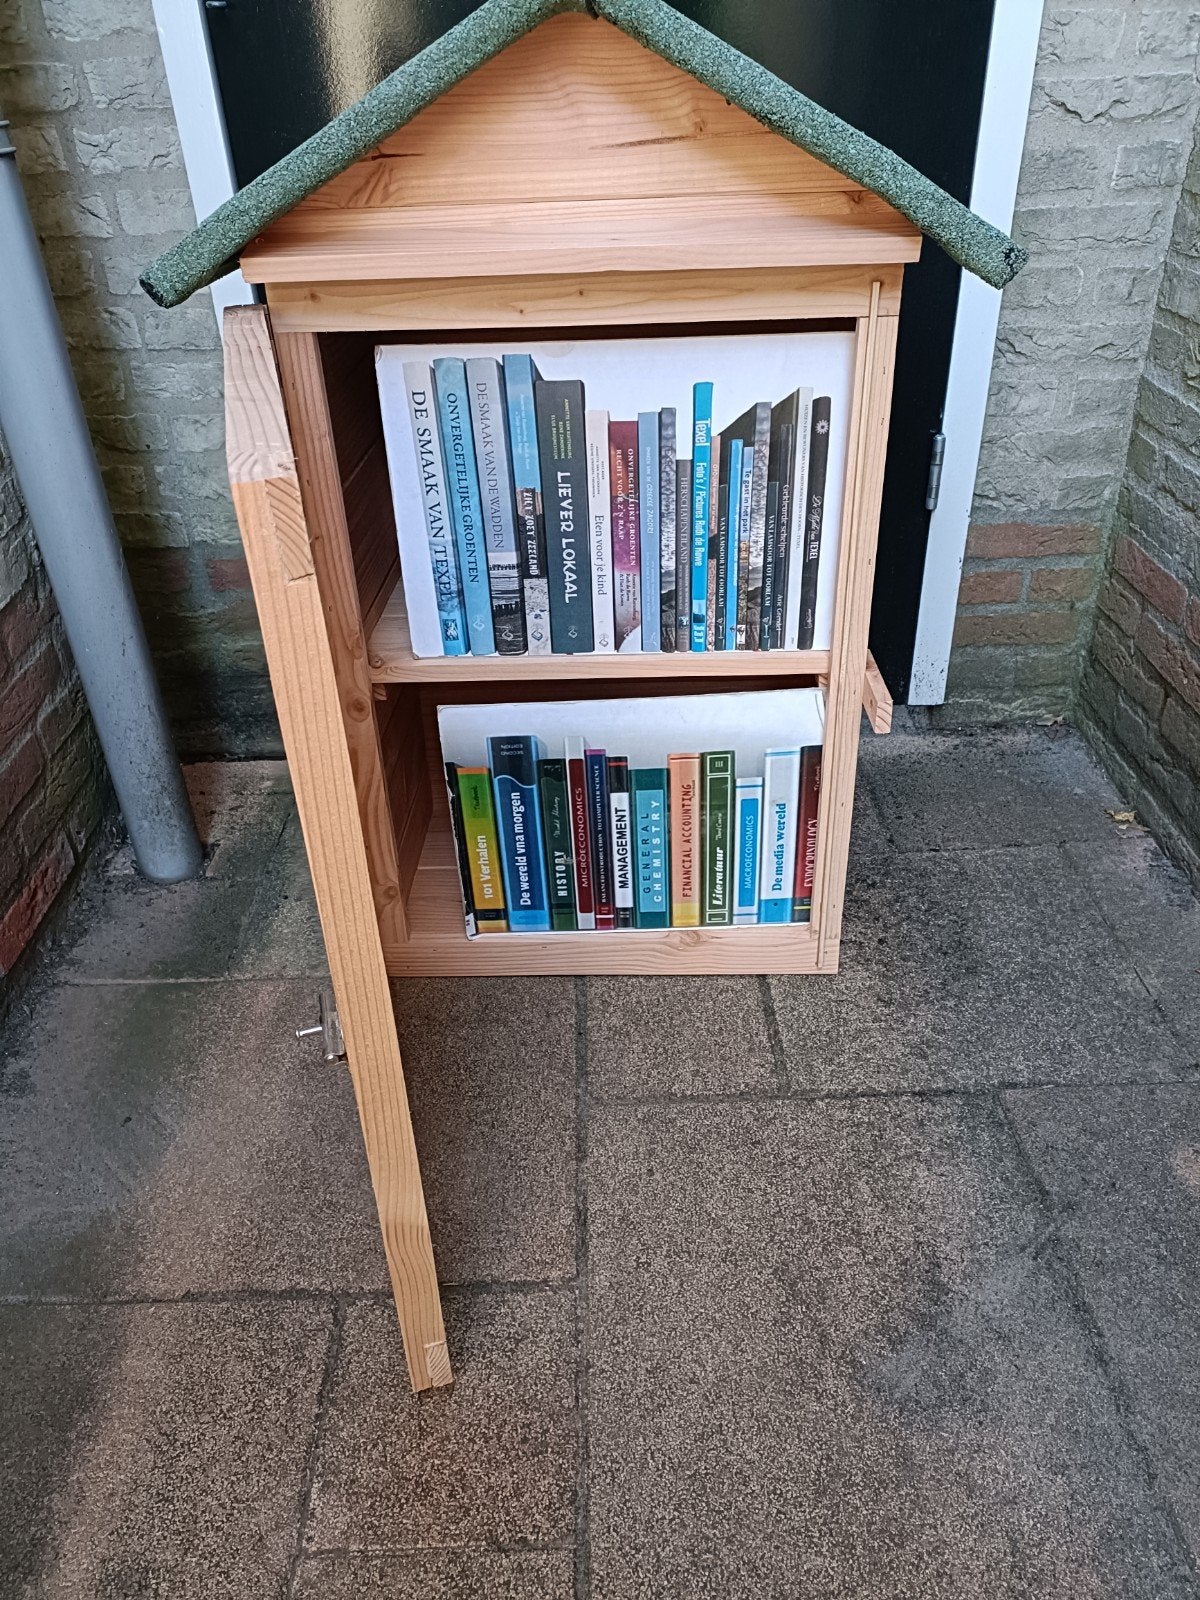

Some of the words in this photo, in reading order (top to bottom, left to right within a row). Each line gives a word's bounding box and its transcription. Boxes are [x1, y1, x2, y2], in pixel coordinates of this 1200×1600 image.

[412, 390, 429, 420] DE
[476, 382, 488, 400] DE
[478, 403, 494, 448] SMAAK
[695, 418, 711, 447] Texel
[417, 427, 439, 496] SMAAK
[485, 450, 497, 476] VAN
[696, 462, 706, 483] Foto's
[744, 469, 752, 479] Te
[446, 393, 471, 512] ONVERGETELIJKE
[462, 514, 479, 583] GROENTEN
[488, 479, 499, 495] DE
[557, 471, 574, 532] LIEVER
[627, 448, 636, 521] ONVERGETELIJKE
[742, 480, 750, 496] gast
[428, 500, 445, 539] VAN
[695, 490, 706, 518] Pictures
[742, 505, 750, 517] het
[489, 496, 504, 549] WADDEN
[595, 515, 604, 536] Eten
[696, 519, 705, 536] Ruth
[741, 518, 749, 533] park
[527, 540, 539, 576] ZEELAND
[629, 523, 637, 566] GROENTEN
[695, 537, 704, 546] de
[695, 547, 704, 566] Ruwe
[809, 541, 819, 560] TEXEL
[434, 546, 452, 602] TEXEL
[562, 538, 578, 603] LOKAAL
[594, 563, 604, 573] je
[598, 574, 607, 595] kind
[510, 792, 525, 833] morgen
[681, 783, 692, 844] ACCOUNTING
[776, 803, 787, 841] wereld
[515, 834, 526, 854] vna
[575, 787, 588, 888] MICROECONOMICS
[615, 807, 629, 889] MANAGEMENT
[641, 812, 651, 894] GENERAL
[651, 801, 662, 903] CHEMISTRY
[744, 815, 755, 889] MACROECONOMICS
[804, 818, 818, 888] ENDOCRINOLOGY
[476, 835, 491, 881] Verhalen
[515, 856, 530, 891] wereld
[554, 851, 568, 897] HISTORY
[682, 847, 693, 898] FINANCIAL
[773, 843, 785, 877] media
[483, 883, 494, 898] 101
[712, 846, 724, 906] Literatuur
[772, 878, 783, 892] De
[520, 892, 532, 905] De
